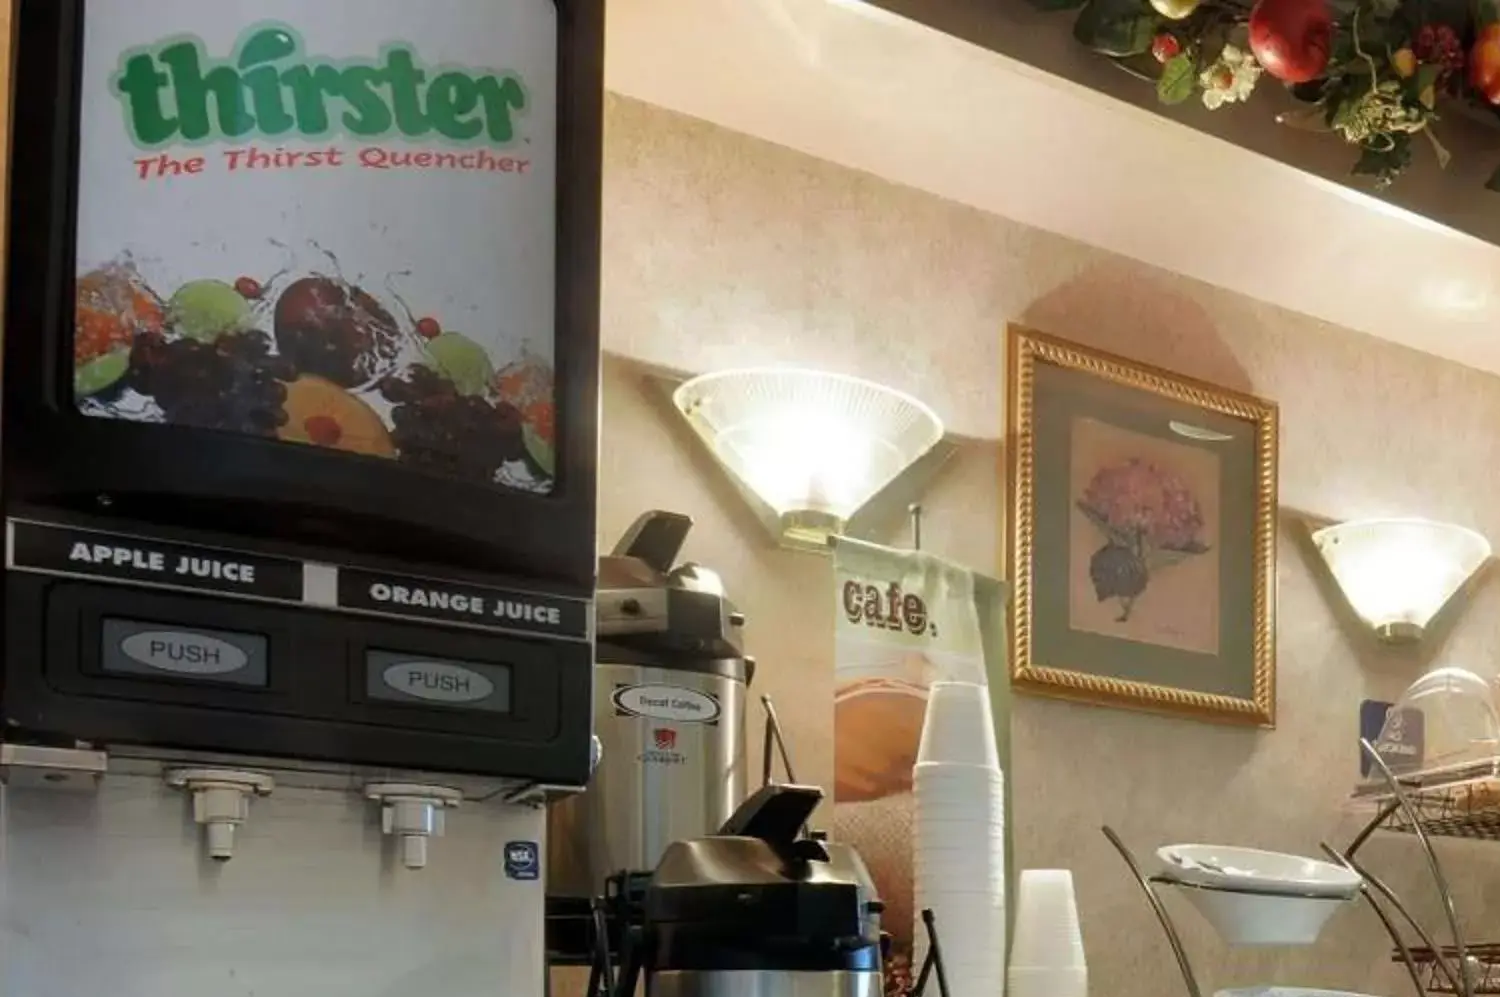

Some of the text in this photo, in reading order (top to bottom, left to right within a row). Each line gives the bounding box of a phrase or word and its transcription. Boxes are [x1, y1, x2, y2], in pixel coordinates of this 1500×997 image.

[116, 28, 526, 146] thirster
[132, 146, 531, 181] The Thirst Quencher
[69, 541, 255, 582] APPLE JUICE
[369, 583, 560, 624] ORANGE JUICE
[150, 640, 220, 665] PUSH
[408, 671, 470, 693] PUSH
